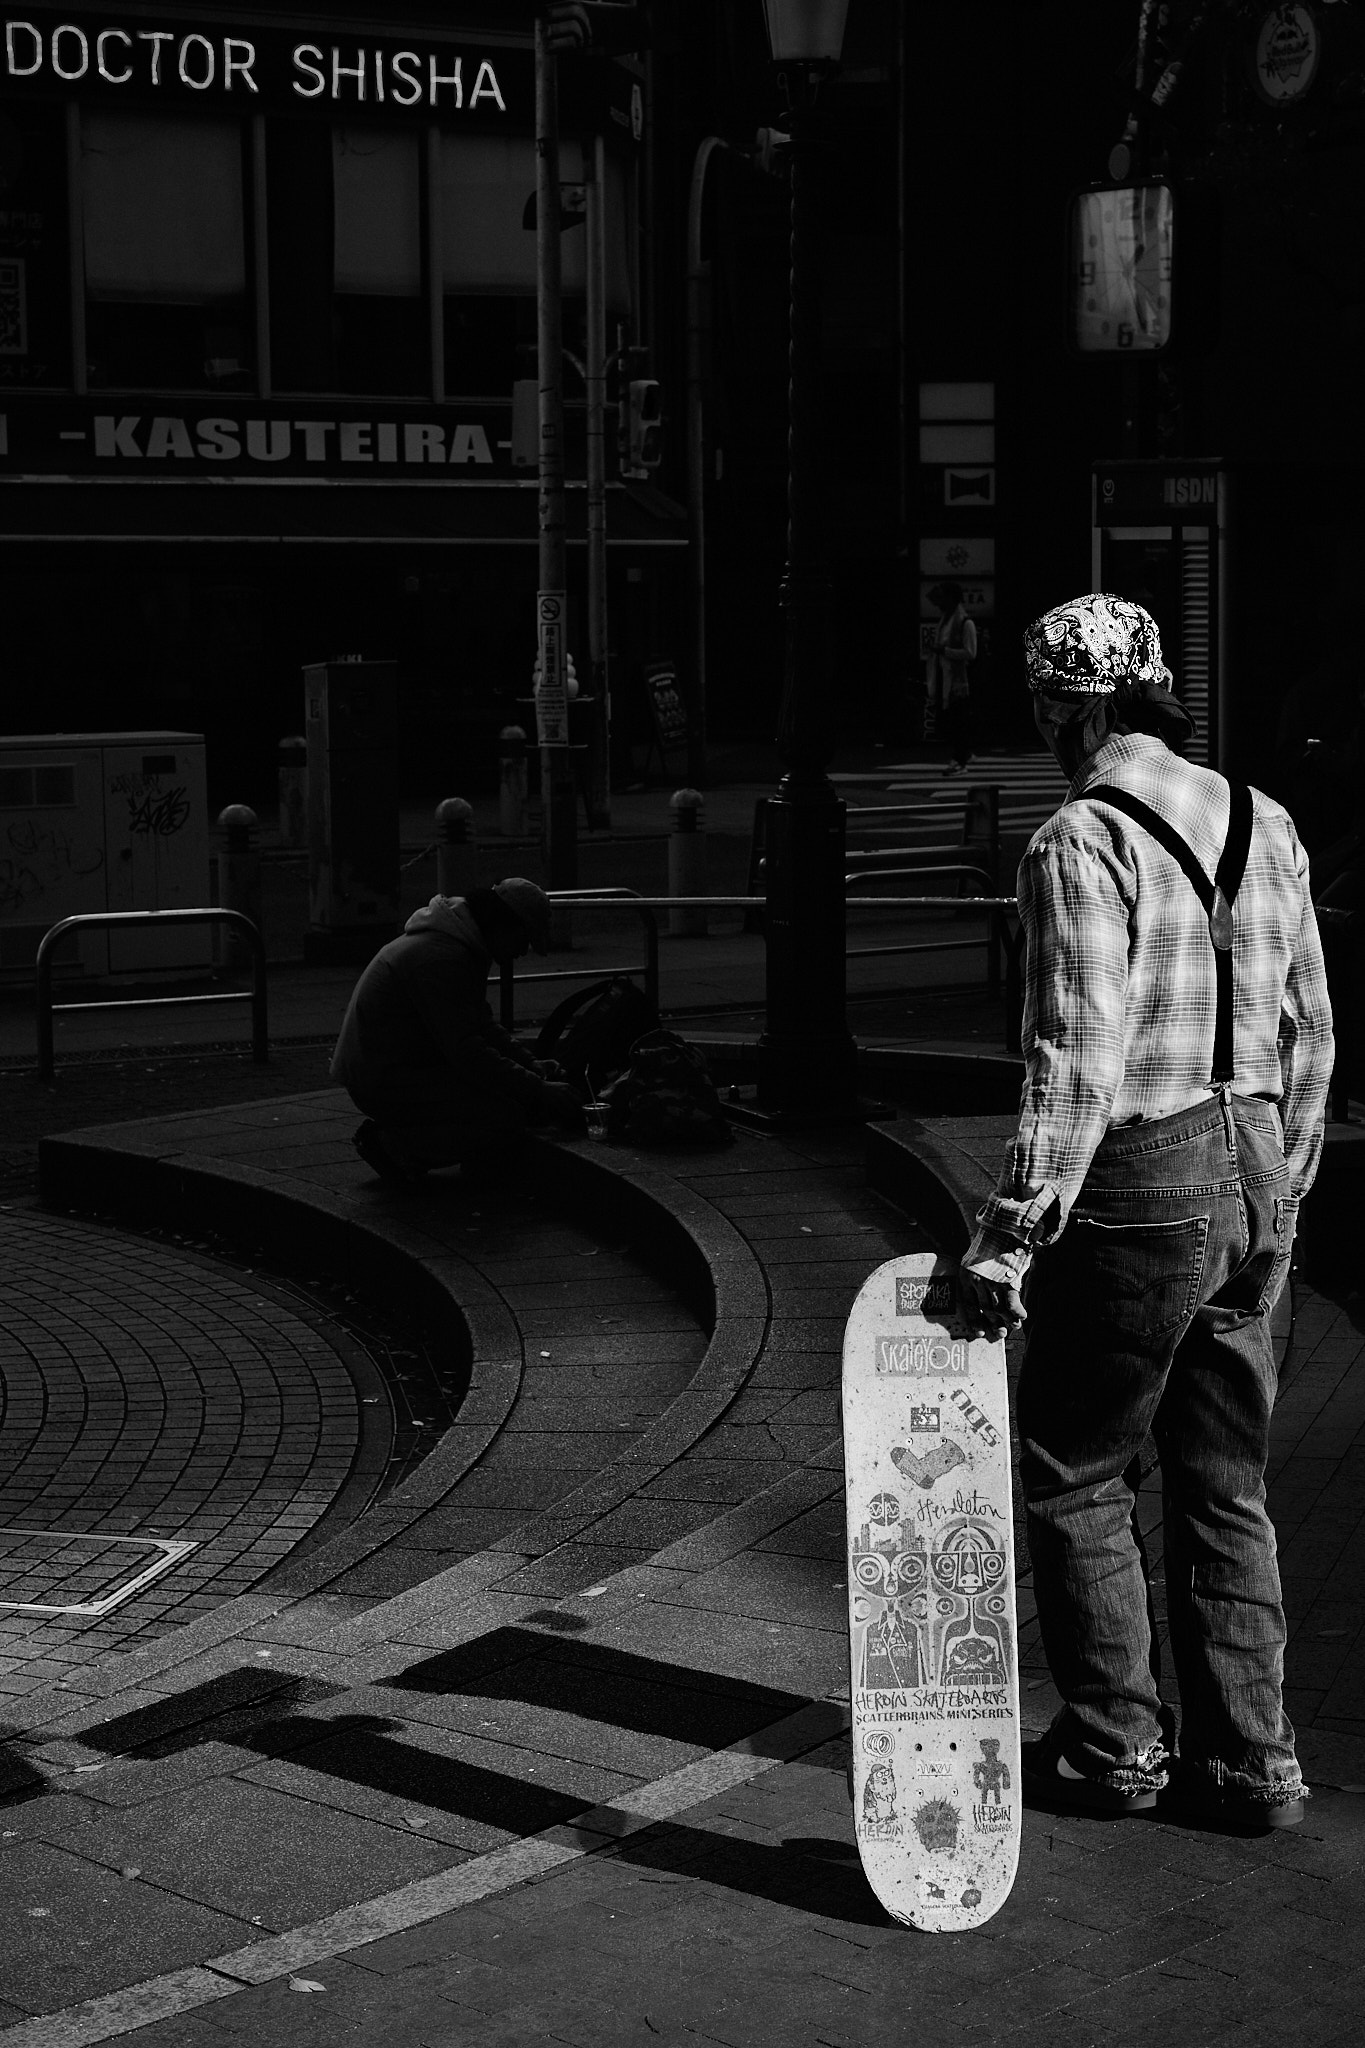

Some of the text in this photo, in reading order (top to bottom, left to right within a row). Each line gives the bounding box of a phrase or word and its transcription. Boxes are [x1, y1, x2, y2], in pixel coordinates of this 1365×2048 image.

[5, 20, 507, 111] DOCTOR SHISHA
[1117, 322, 1134, 348] 6
[1164, 477, 1215, 504] ISDN
[855, 1688, 1007, 1712] HEROIN SKATEBOARDS
[972, 1804, 1012, 1825] HEROIN
[858, 1823, 904, 1838] HEROIN
